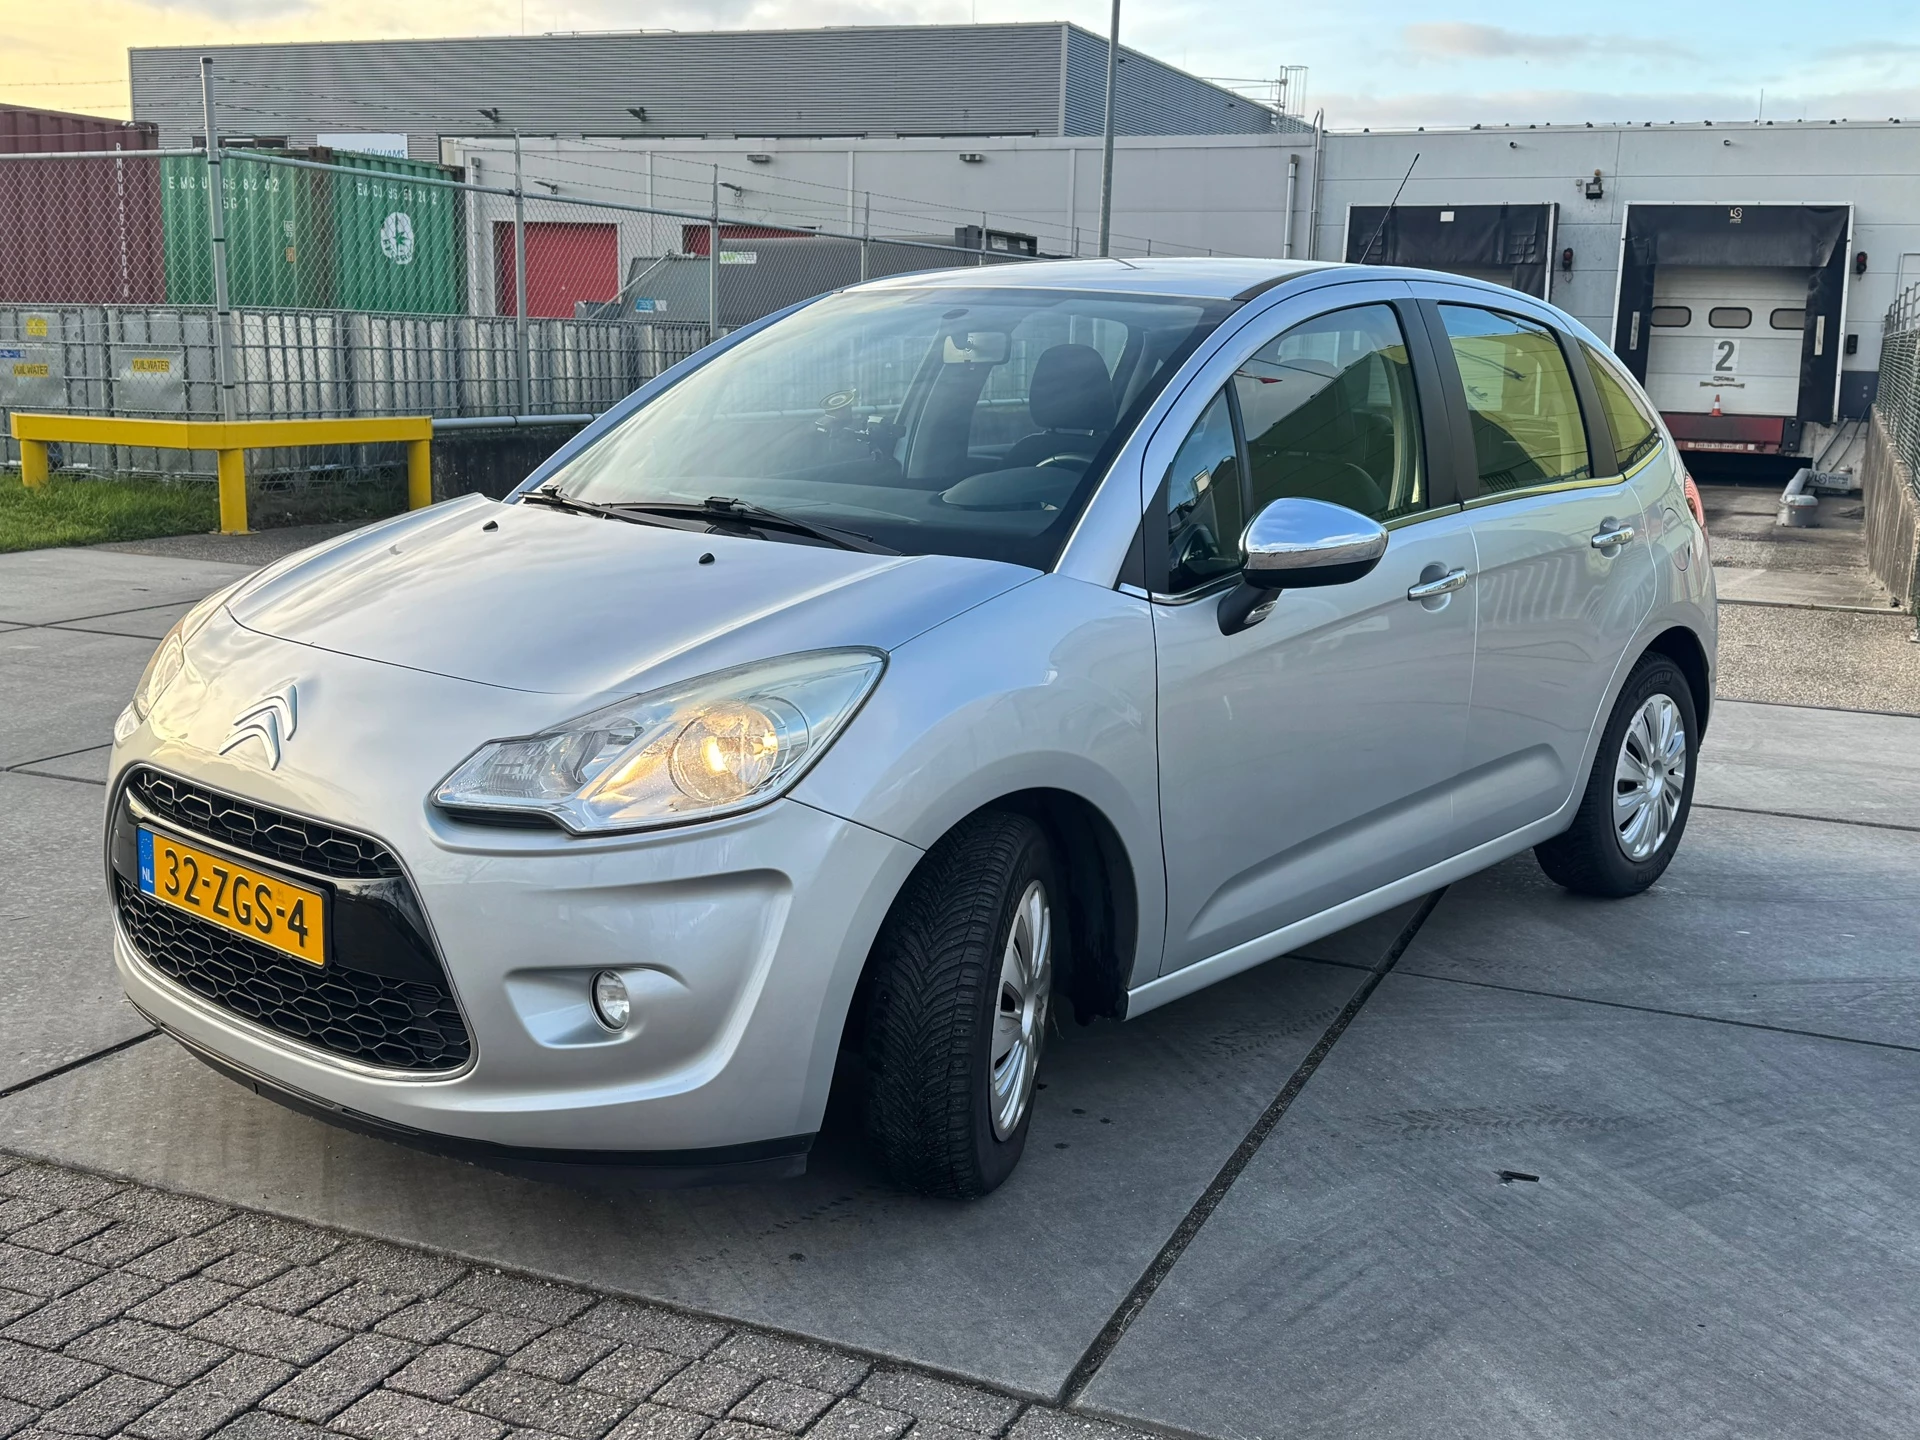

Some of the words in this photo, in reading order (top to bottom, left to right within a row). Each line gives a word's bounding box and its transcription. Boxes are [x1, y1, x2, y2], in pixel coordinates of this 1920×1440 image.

[147, 360, 170, 370] WATER
[1715, 340, 1735, 372] 2
[27, 365, 48, 376] WATER
[141, 865, 153, 884] NL
[163, 848, 309, 948] 32-ZGS-4
